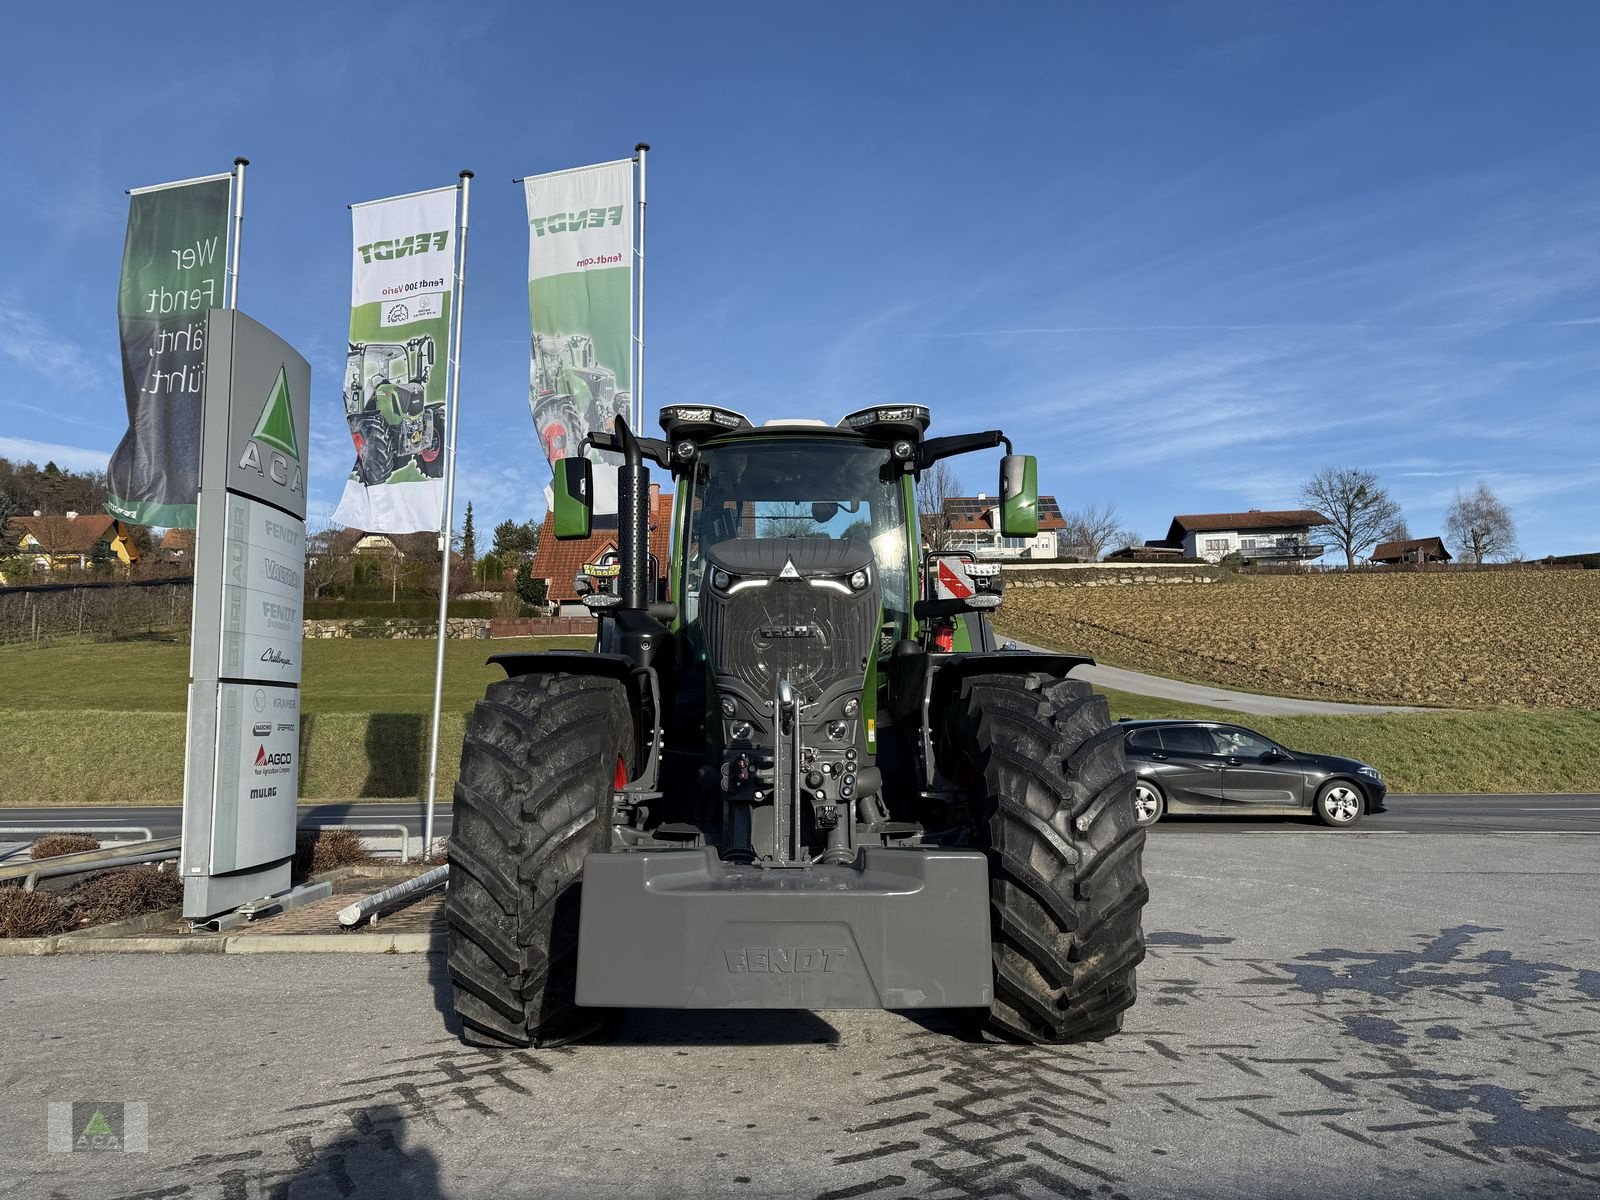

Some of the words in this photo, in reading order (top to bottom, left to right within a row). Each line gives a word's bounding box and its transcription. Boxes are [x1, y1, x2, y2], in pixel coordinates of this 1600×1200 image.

[238, 439, 305, 498] ACA
[264, 519, 299, 547] FENDT
[262, 601, 297, 623] FENDT
[760, 624, 817, 639] FENDT
[267, 753, 292, 765] AGCO
[723, 945, 849, 974] FENDT
